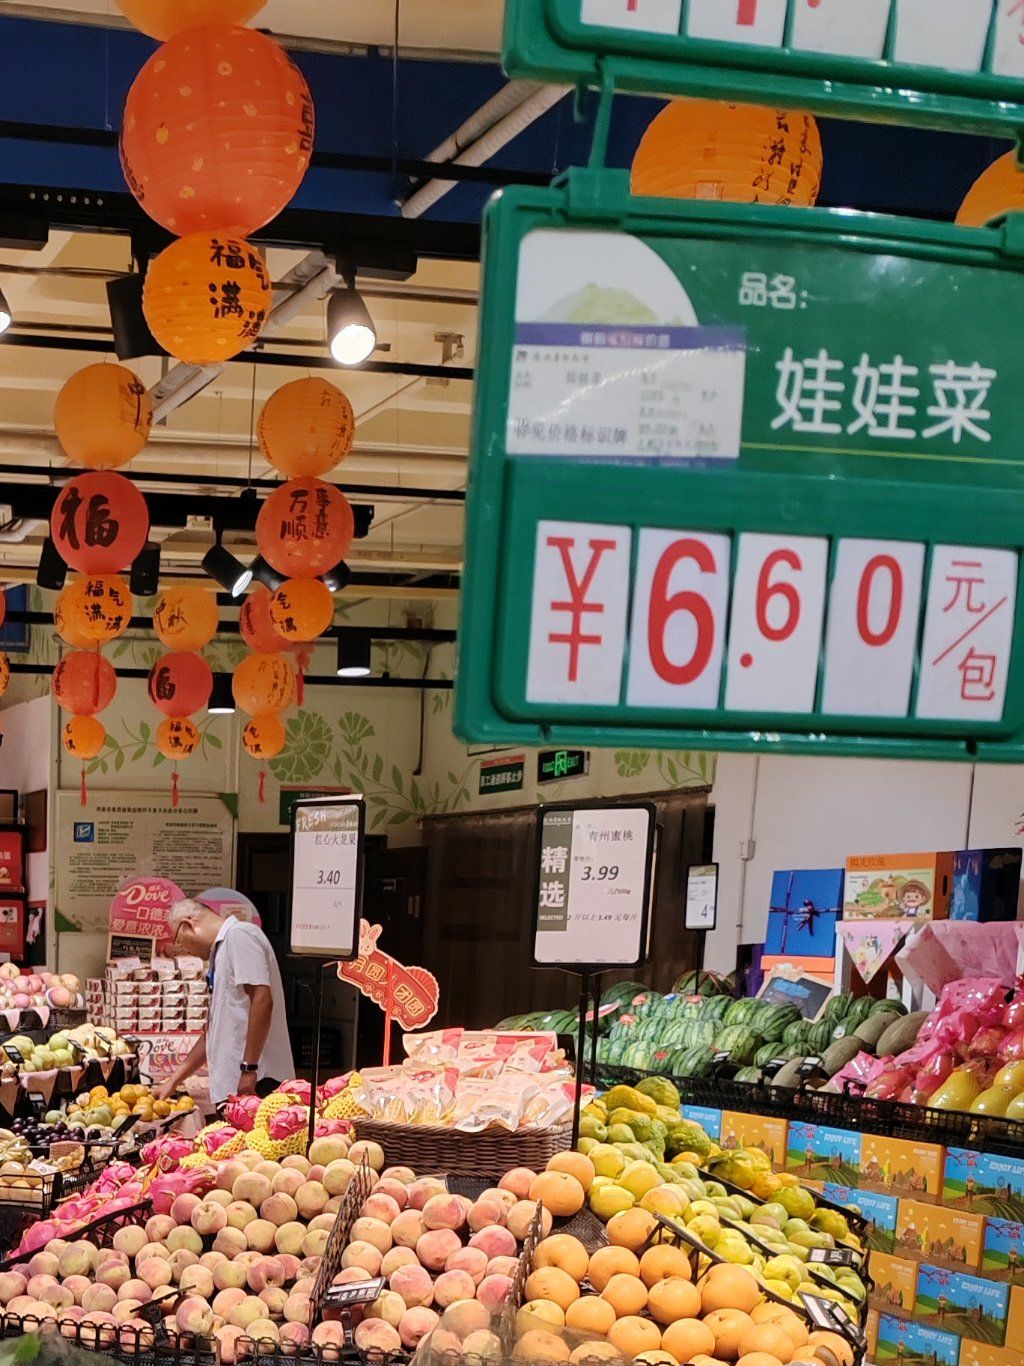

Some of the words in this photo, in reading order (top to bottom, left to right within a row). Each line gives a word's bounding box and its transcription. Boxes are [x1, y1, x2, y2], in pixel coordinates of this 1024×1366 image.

[770, 347, 997, 445] 娃娃菜
[59, 487, 120, 550] 福
[314, 832, 356, 847] 红心火龙果
[317, 870, 341, 885] 3.40
[539, 845, 569, 909] 精选
[581, 866, 619, 881] 3.99
[120, 885, 171, 905] Dove
[824, 1133, 843, 1143] ENJOY
[989, 1161, 1011, 1173] ENJOY
[962, 1282, 984, 1293] ENJOY
[983, 1287, 1002, 1299] LIFE
